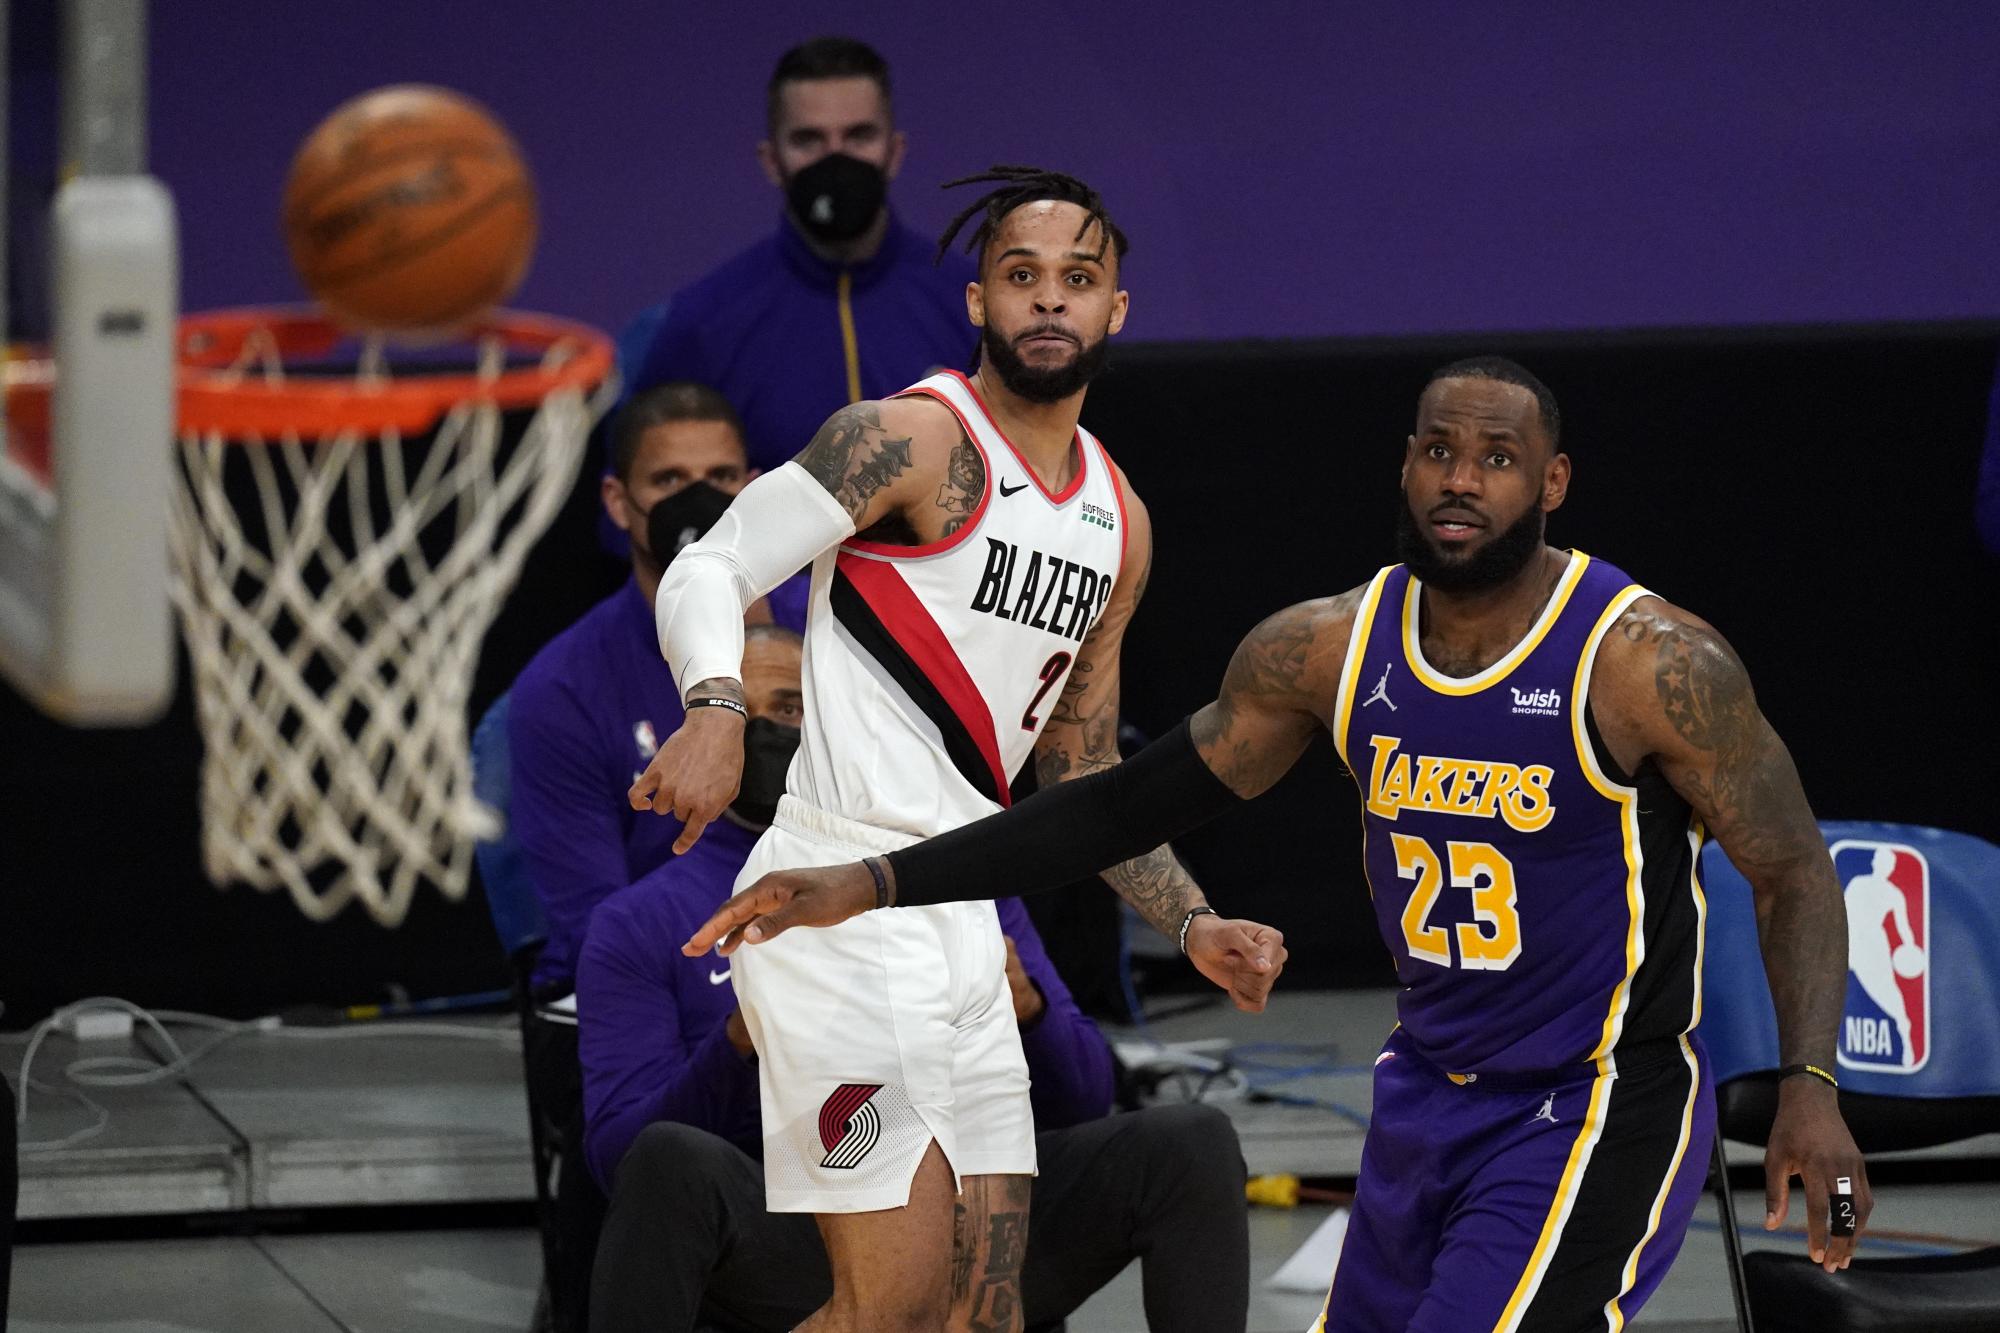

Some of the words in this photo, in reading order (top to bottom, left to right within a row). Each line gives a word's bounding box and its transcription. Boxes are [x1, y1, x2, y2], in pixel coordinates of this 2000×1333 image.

[1082, 502, 1114, 522] BIOFREEZE
[1021, 650, 1072, 732] 2
[1510, 686, 1561, 708] wish
[1512, 706, 1559, 716] SHOPPING
[1367, 734, 1556, 833] LAKERS
[1390, 832, 1522, 971] 23
[1845, 1015, 1892, 1056] NBA
